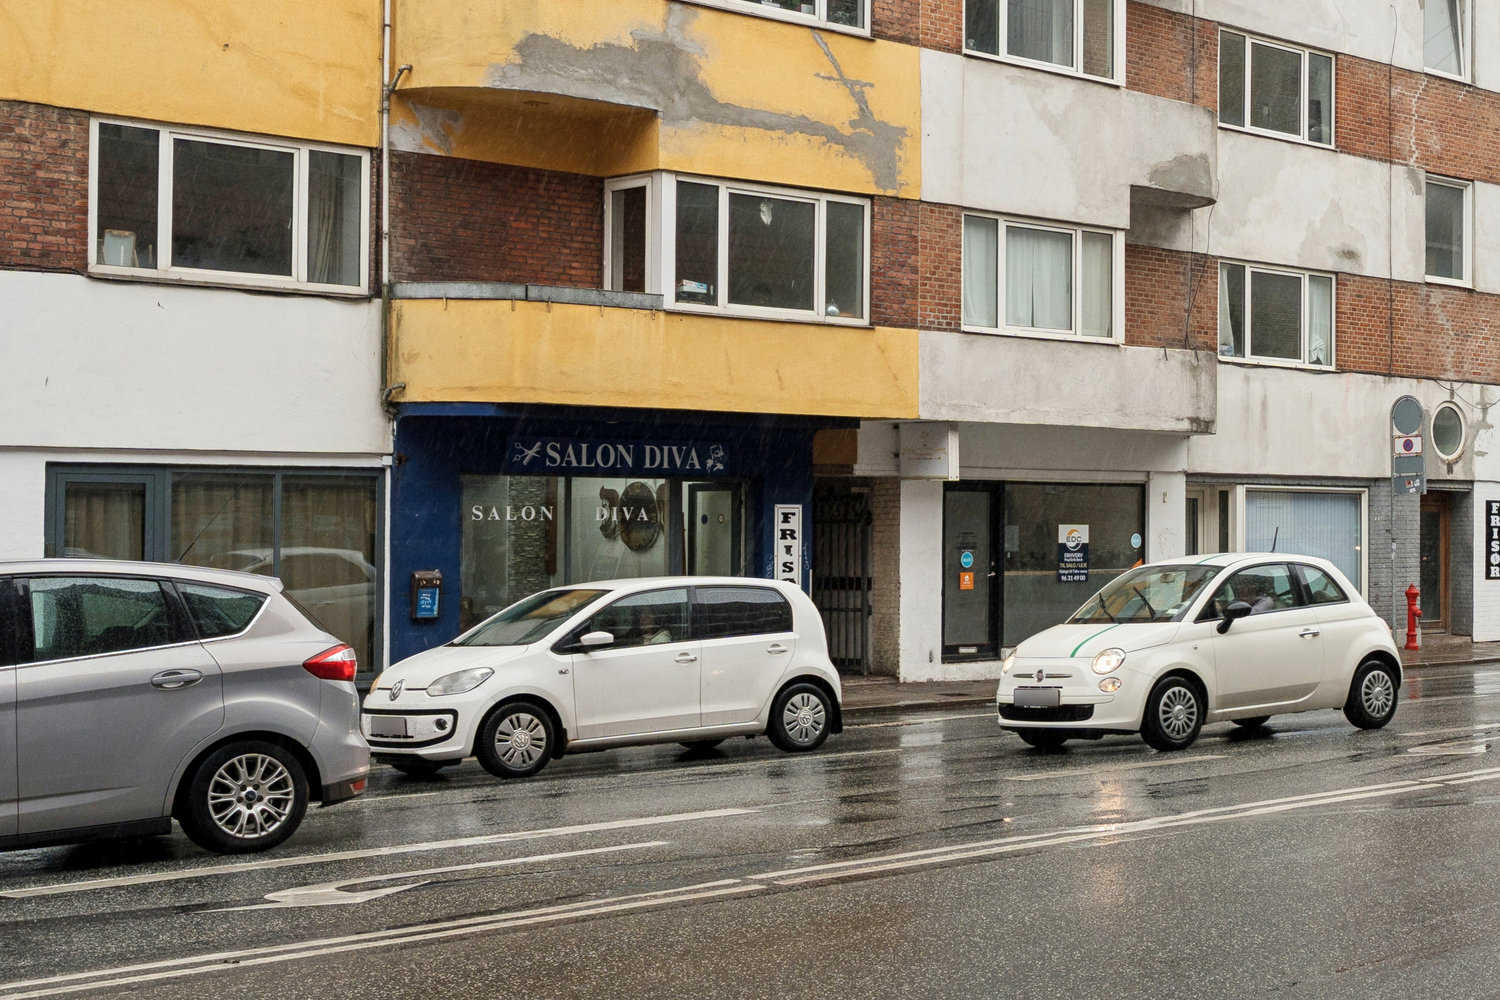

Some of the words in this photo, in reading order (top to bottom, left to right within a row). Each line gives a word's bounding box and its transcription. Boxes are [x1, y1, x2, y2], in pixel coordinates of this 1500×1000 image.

[546, 442, 634, 467] SALON
[644, 446, 701, 470] DIVA
[472, 505, 553, 520] SALON
[595, 506, 648, 521] DIVA
[779, 512, 797, 584] FRIS
[1490, 502, 1500, 577] FRISØR
